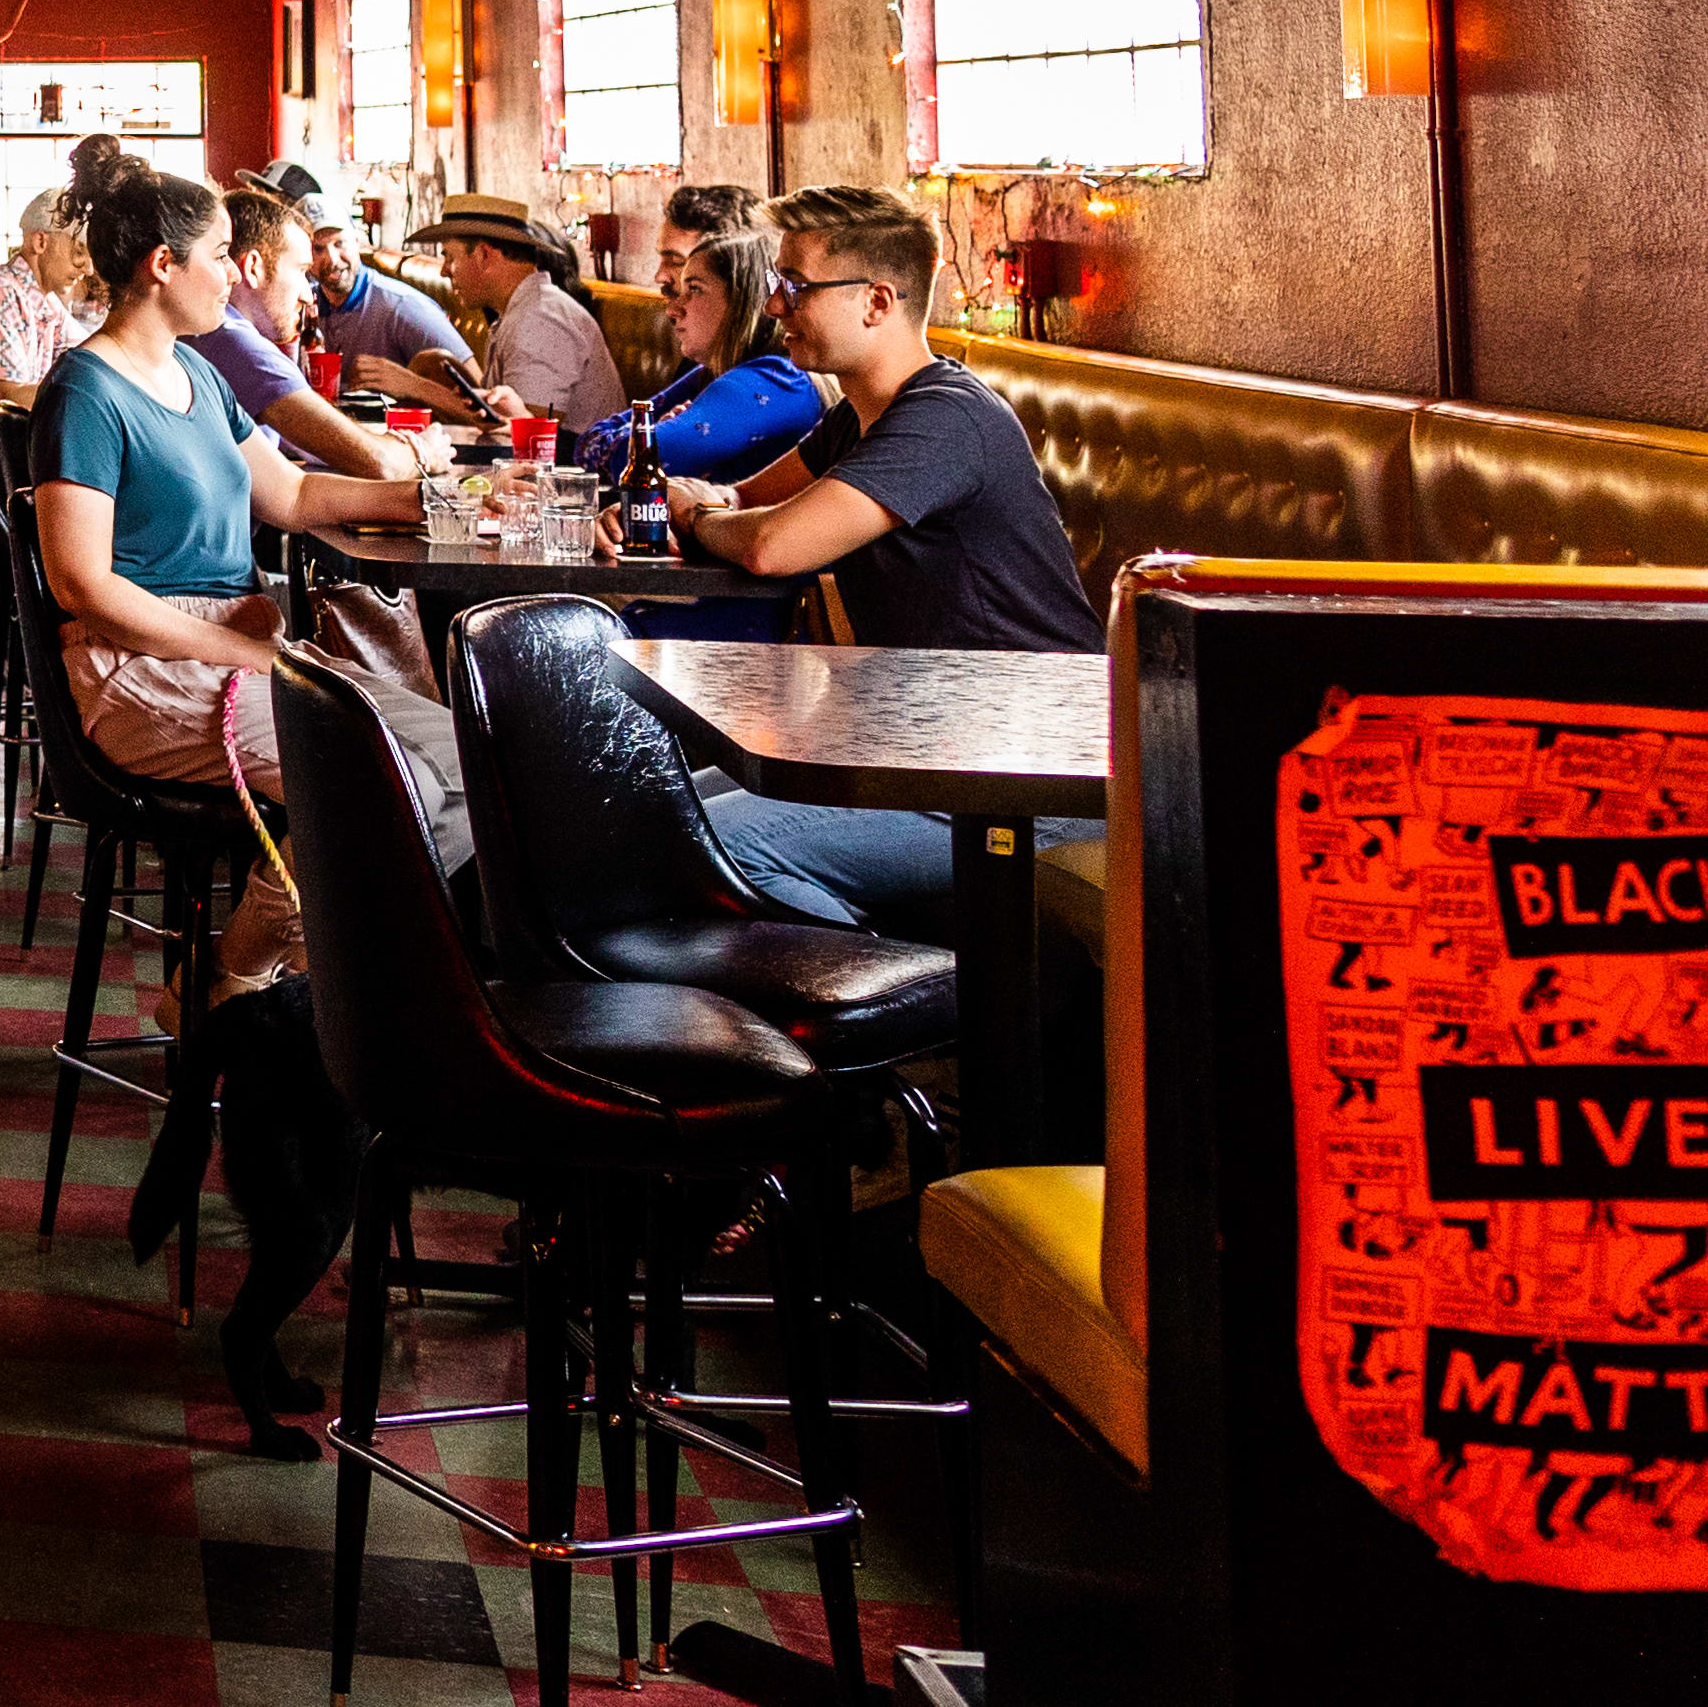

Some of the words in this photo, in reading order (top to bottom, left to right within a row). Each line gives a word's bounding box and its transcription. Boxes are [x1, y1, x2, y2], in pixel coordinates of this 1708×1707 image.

[630, 503, 667, 522] Blue
[1510, 860, 1708, 926] BLAC
[1469, 1097, 1708, 1168] LIVE
[1437, 1349, 1708, 1433] MATT
